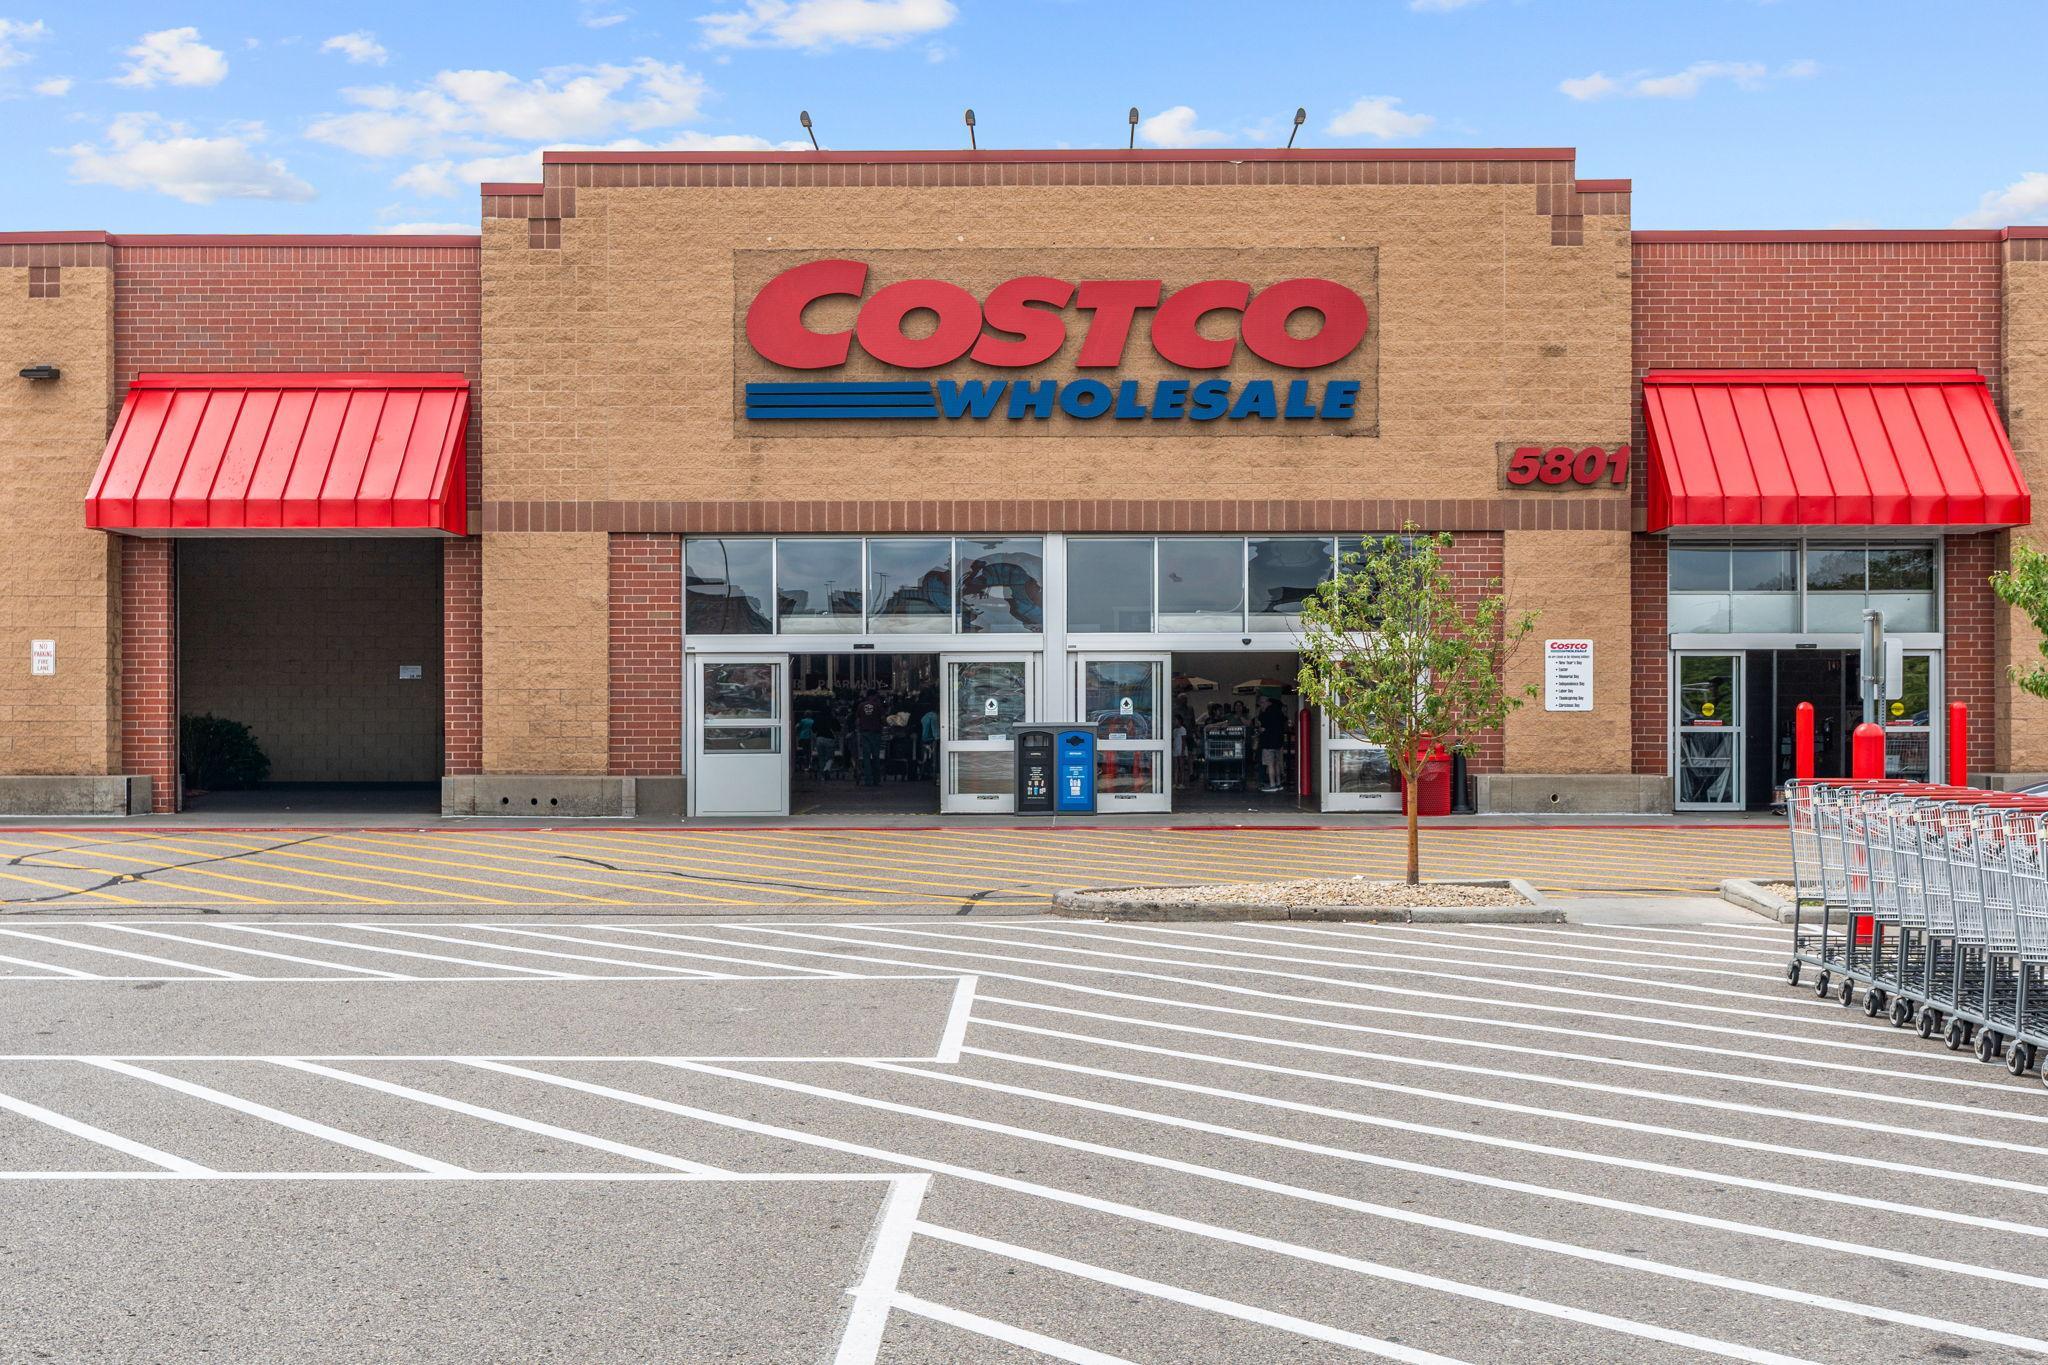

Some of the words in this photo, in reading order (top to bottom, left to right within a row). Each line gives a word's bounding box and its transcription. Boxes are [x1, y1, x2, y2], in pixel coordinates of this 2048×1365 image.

[745, 259, 1368, 369] COSTCO
[936, 379, 1360, 420] WHOLESALE
[1506, 445, 1631, 485] 5801
